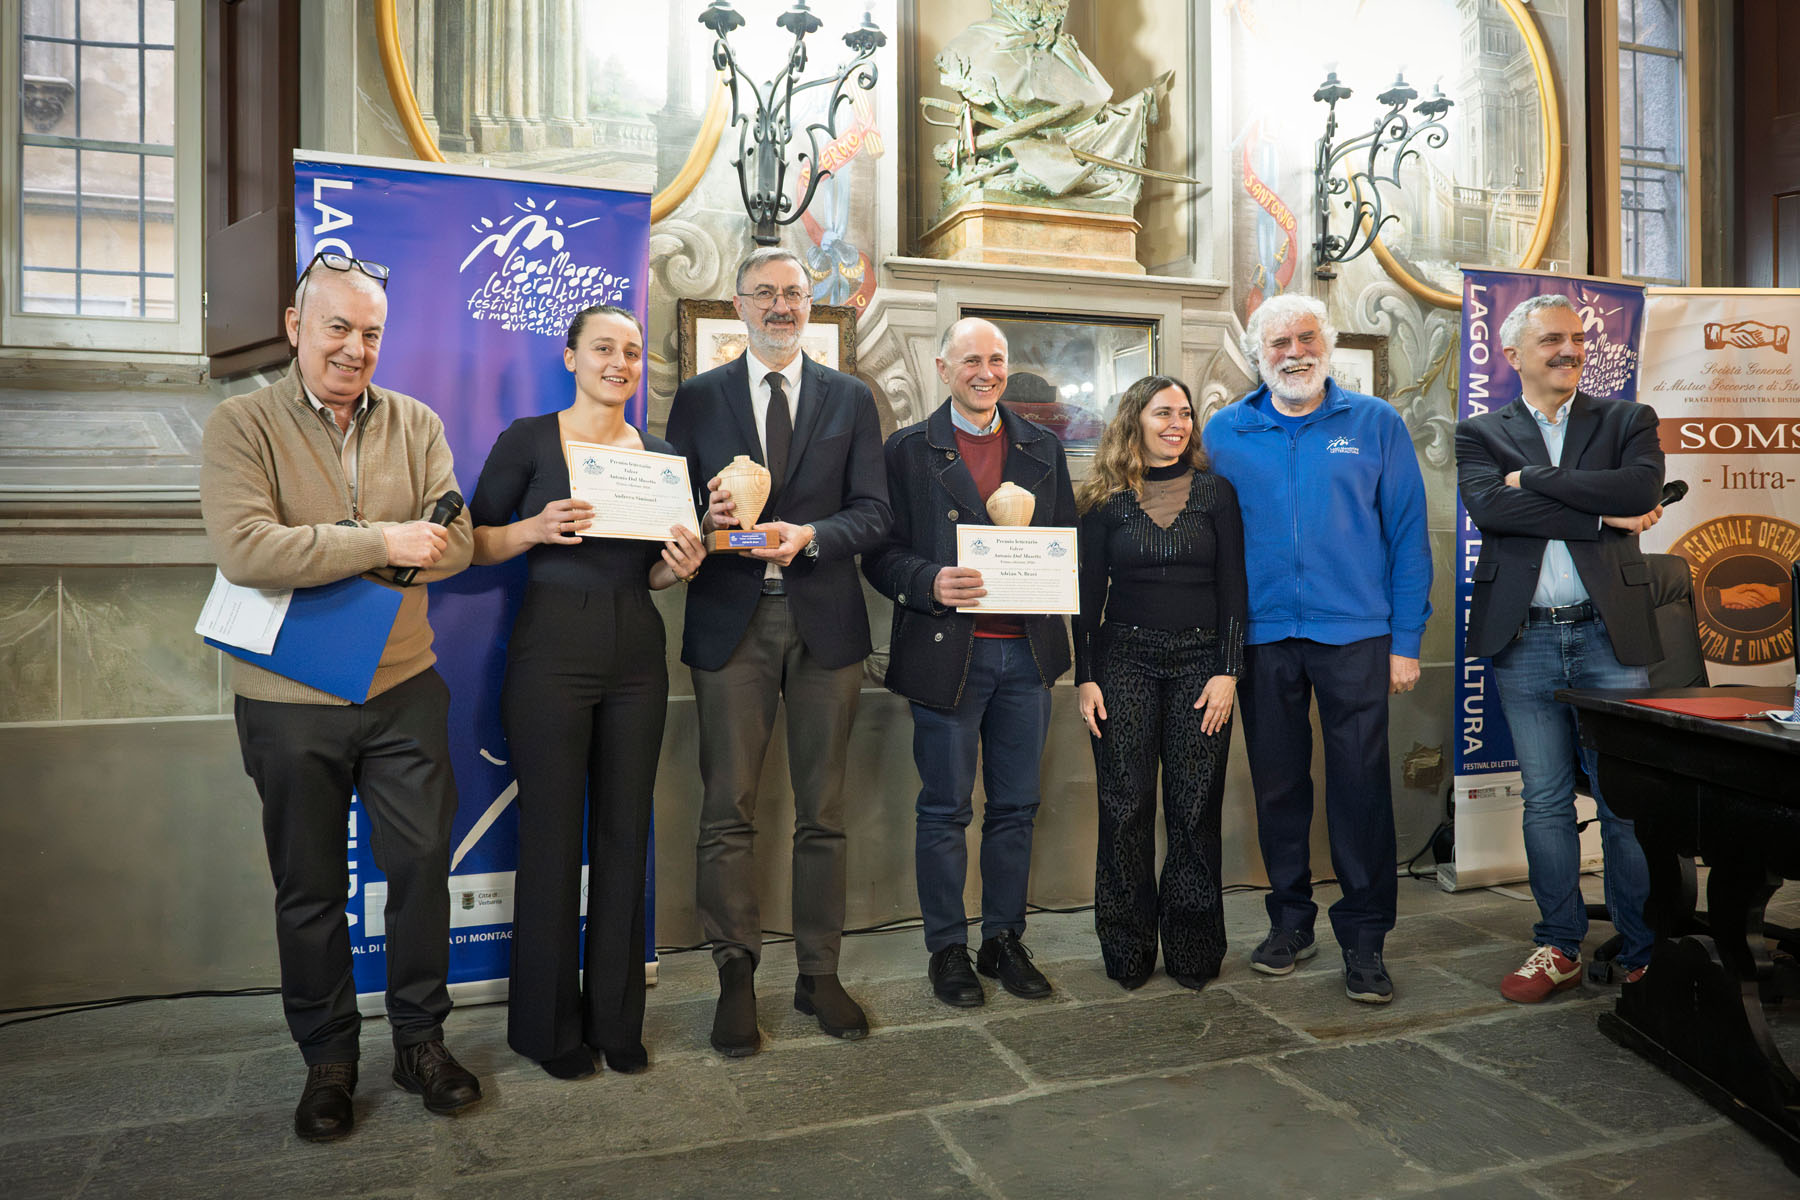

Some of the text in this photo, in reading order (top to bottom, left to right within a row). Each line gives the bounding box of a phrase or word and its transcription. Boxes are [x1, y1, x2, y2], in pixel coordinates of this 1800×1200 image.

[818, 133, 860, 170] ERMO
[548, 251, 630, 290] Maggiore
[467, 288, 524, 313] festival
[525, 297, 537, 310] di
[472, 310, 486, 320] di
[1469, 283, 1490, 365] LAGO
[501, 320, 569, 337] avventur
[1583, 352, 1627, 373] raltura
[1745, 360, 1793, 376] Generale
[1468, 373, 1490, 419] MA
[1653, 380, 1667, 392] di
[1665, 378, 1706, 392] Mutuo
[1708, 377, 1755, 392] Soccorso
[1766, 380, 1777, 391] di
[1683, 519, 1753, 564] GENERALE
[1732, 639, 1743, 662] E
[1748, 626, 1794, 662] DINTOR
[1498, 759, 1520, 768] LETTER
[455, 935, 467, 945] DI
[469, 930, 513, 943] MONTAG
